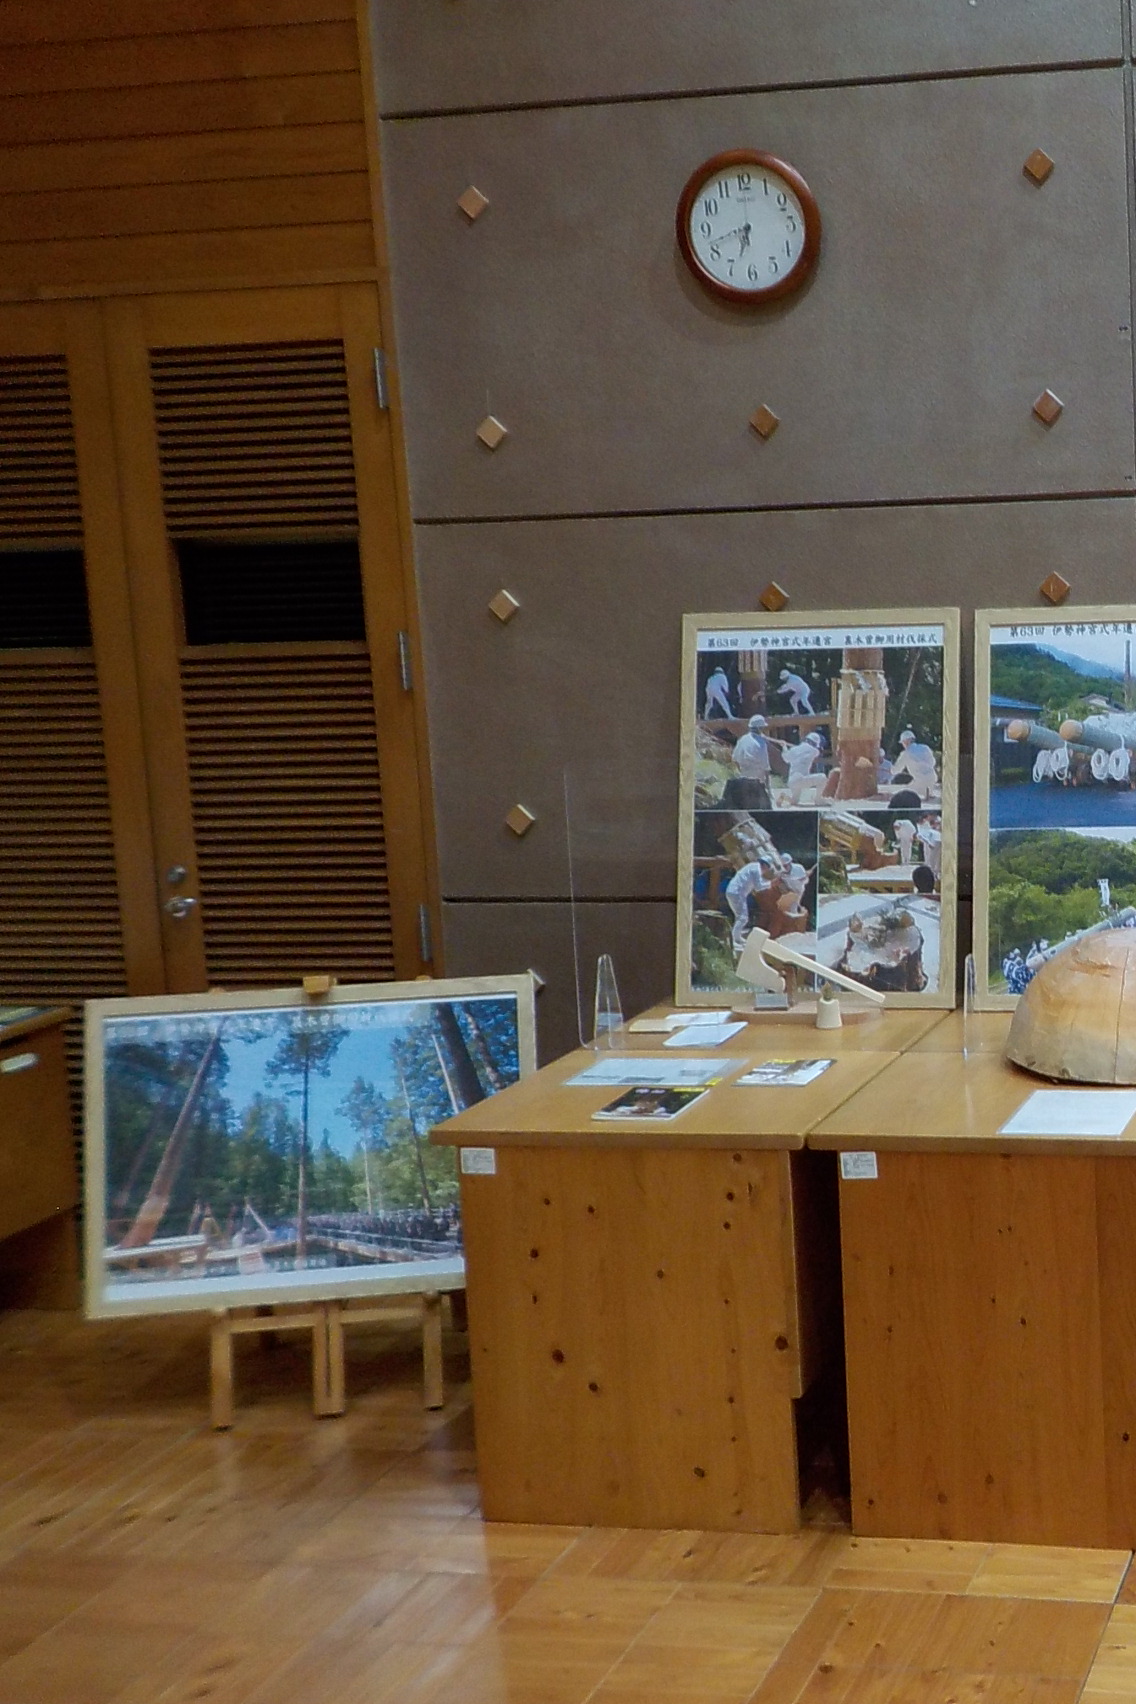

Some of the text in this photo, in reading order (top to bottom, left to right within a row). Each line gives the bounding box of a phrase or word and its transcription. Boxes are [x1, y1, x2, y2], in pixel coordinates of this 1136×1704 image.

[718, 180, 730, 198] 11
[737, 172, 751, 191] 12
[762, 178, 769, 196] 1
[704, 198, 718, 216] 10
[777, 193, 787, 212] 2
[700, 222, 711, 239] 9
[786, 216, 796, 232] 3
[710, 244, 722, 260] 8
[727, 259, 735, 277] 7
[747, 264, 758, 281] 6
[768, 257, 778, 273] 5
